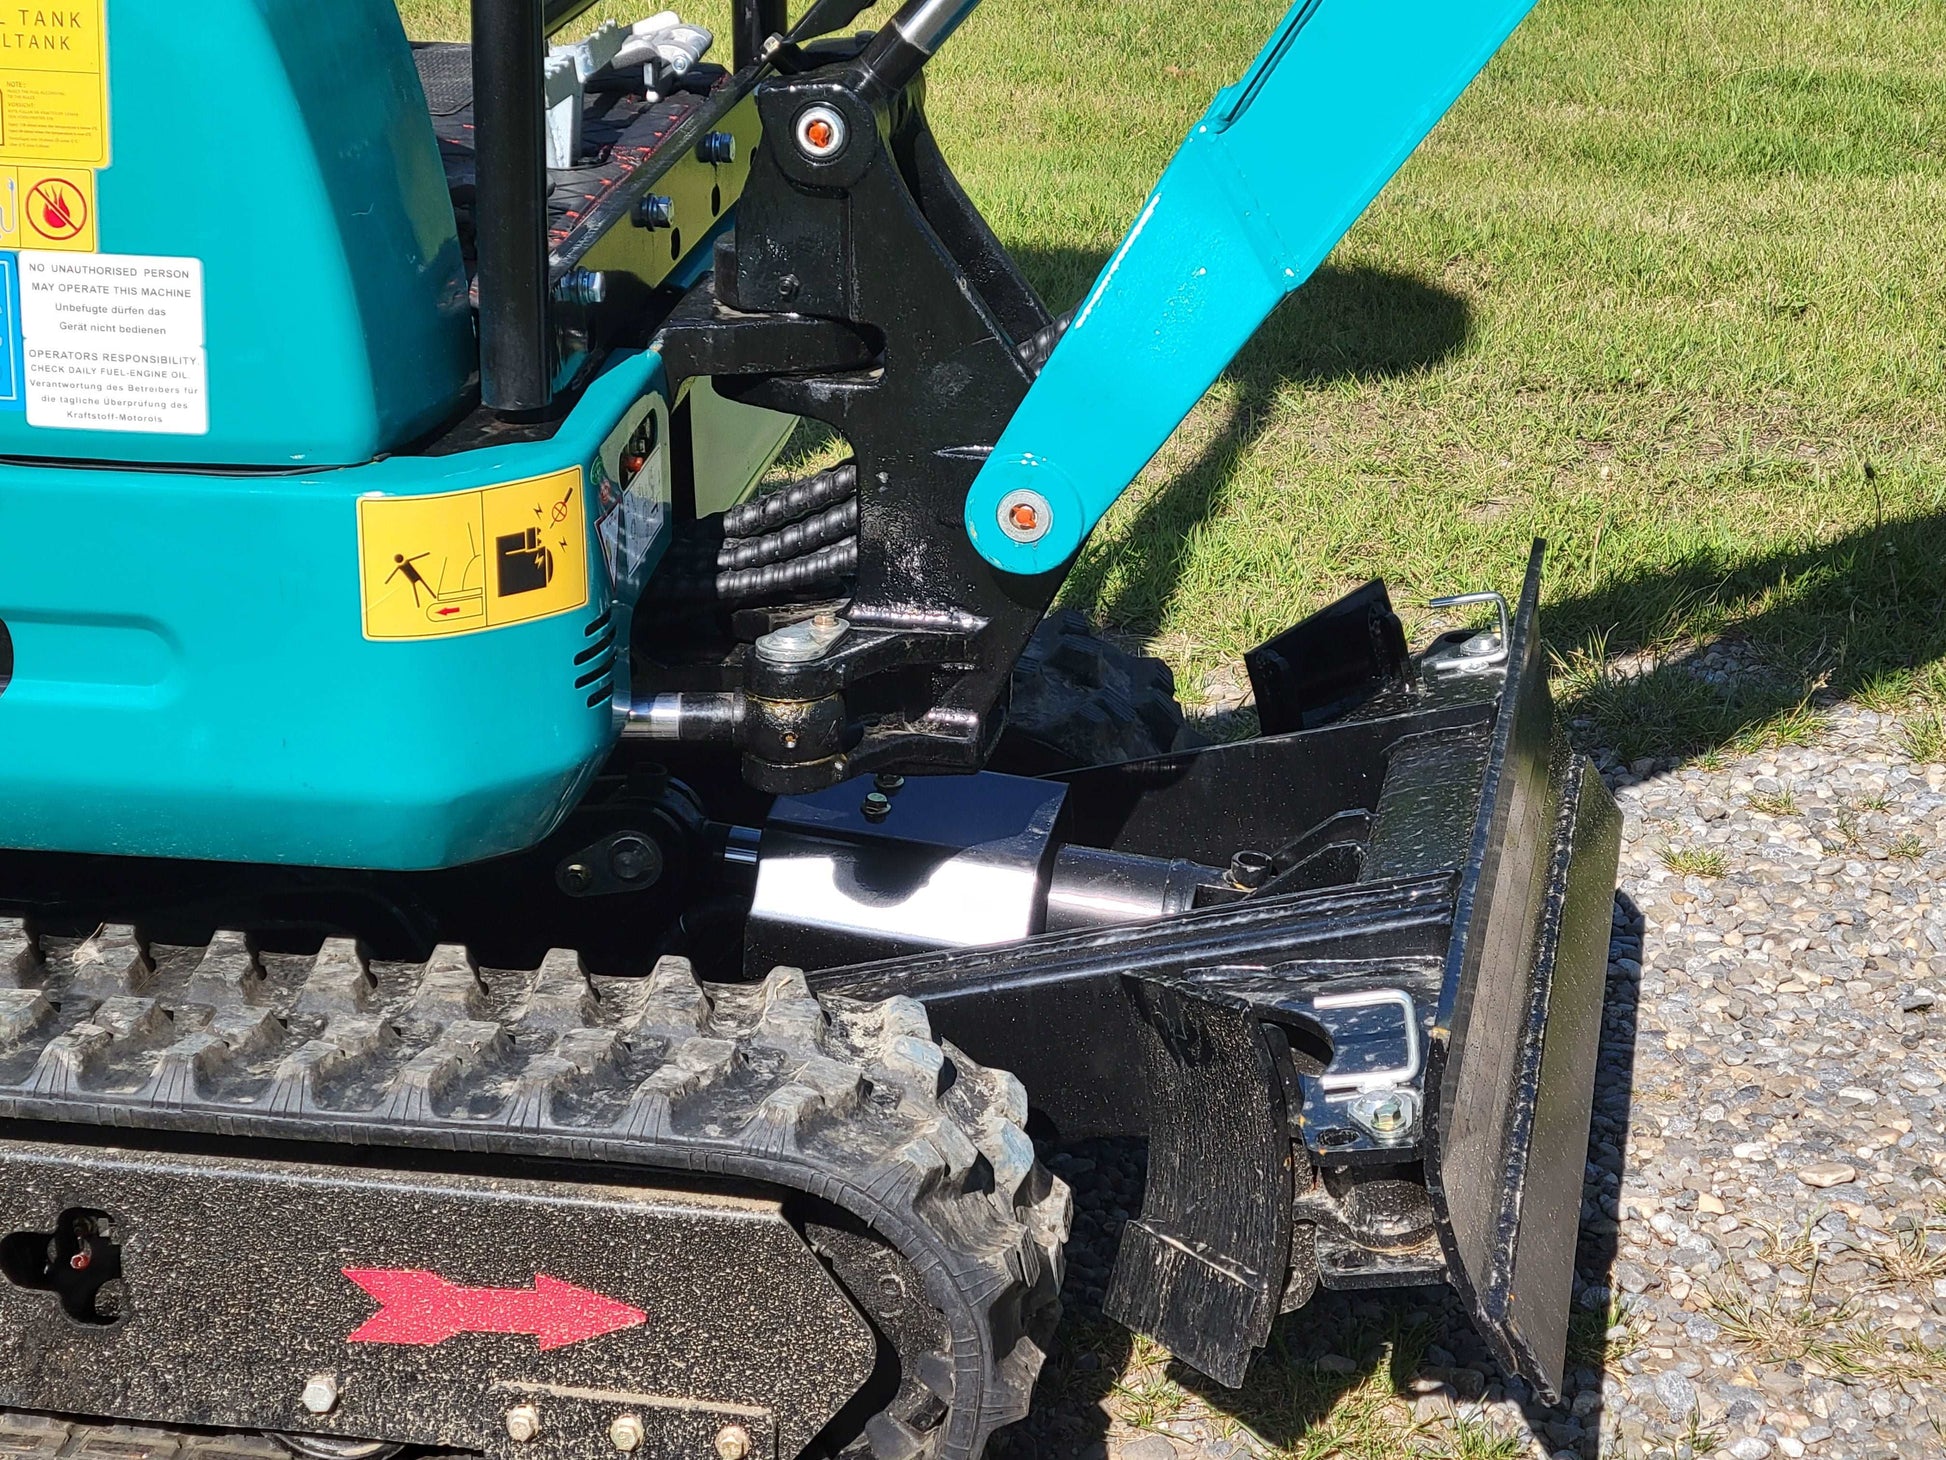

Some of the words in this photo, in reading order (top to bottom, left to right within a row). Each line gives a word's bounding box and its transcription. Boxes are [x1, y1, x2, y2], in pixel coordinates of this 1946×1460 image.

[17, 9, 81, 28] TANK
[29, 263, 45, 272] NO
[51, 264, 138, 277] UNAUTHORISED
[143, 269, 189, 279] PERSON
[31, 282, 54, 291] MAY
[58, 284, 110, 295] OPERATE
[114, 286, 138, 296] THIS
[141, 288, 192, 298] MACHINE
[55, 303, 108, 315] Unbefugte
[111, 305, 144, 316] dürfen
[147, 307, 166, 316] das
[59, 321, 87, 332] Gerät
[90, 323, 116, 333] nicht
[119, 325, 167, 335] bedienen
[28, 349, 98, 361] OPERATORS
[30, 364, 65, 373] CHECK
[68, 366, 97, 375] DAILY
[100, 368, 168, 379] FUEL-ENGINE
[29, 379, 103, 392] Verantwortung
[106, 383, 124, 391] des
[127, 384, 180, 394] Betreibers
[41, 395, 56, 403] die
[170, 401, 188, 409] des
